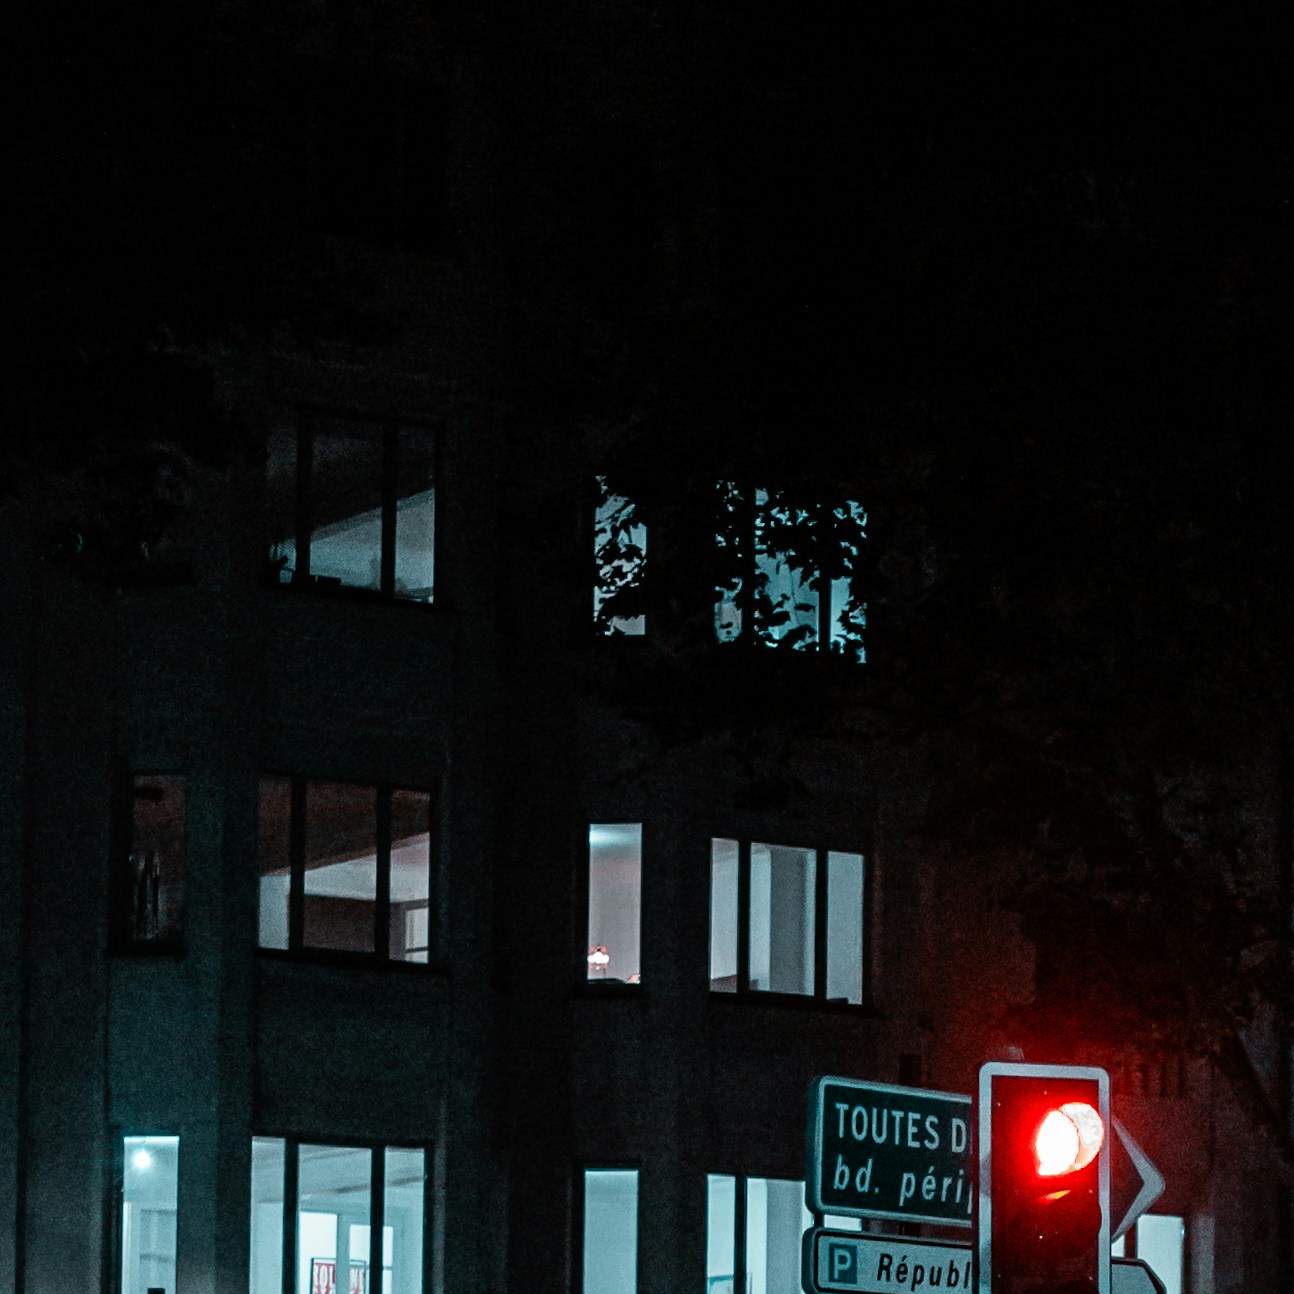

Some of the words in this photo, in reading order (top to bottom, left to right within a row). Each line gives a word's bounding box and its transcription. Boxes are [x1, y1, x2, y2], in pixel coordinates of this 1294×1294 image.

[835, 1103, 940, 1151] TOUTES
[951, 1117, 968, 1153] D
[833, 1155, 879, 1194] bd.
[899, 1166, 973, 1214] péri
[833, 1249, 852, 1280] P
[877, 1253, 971, 1291] Républ
